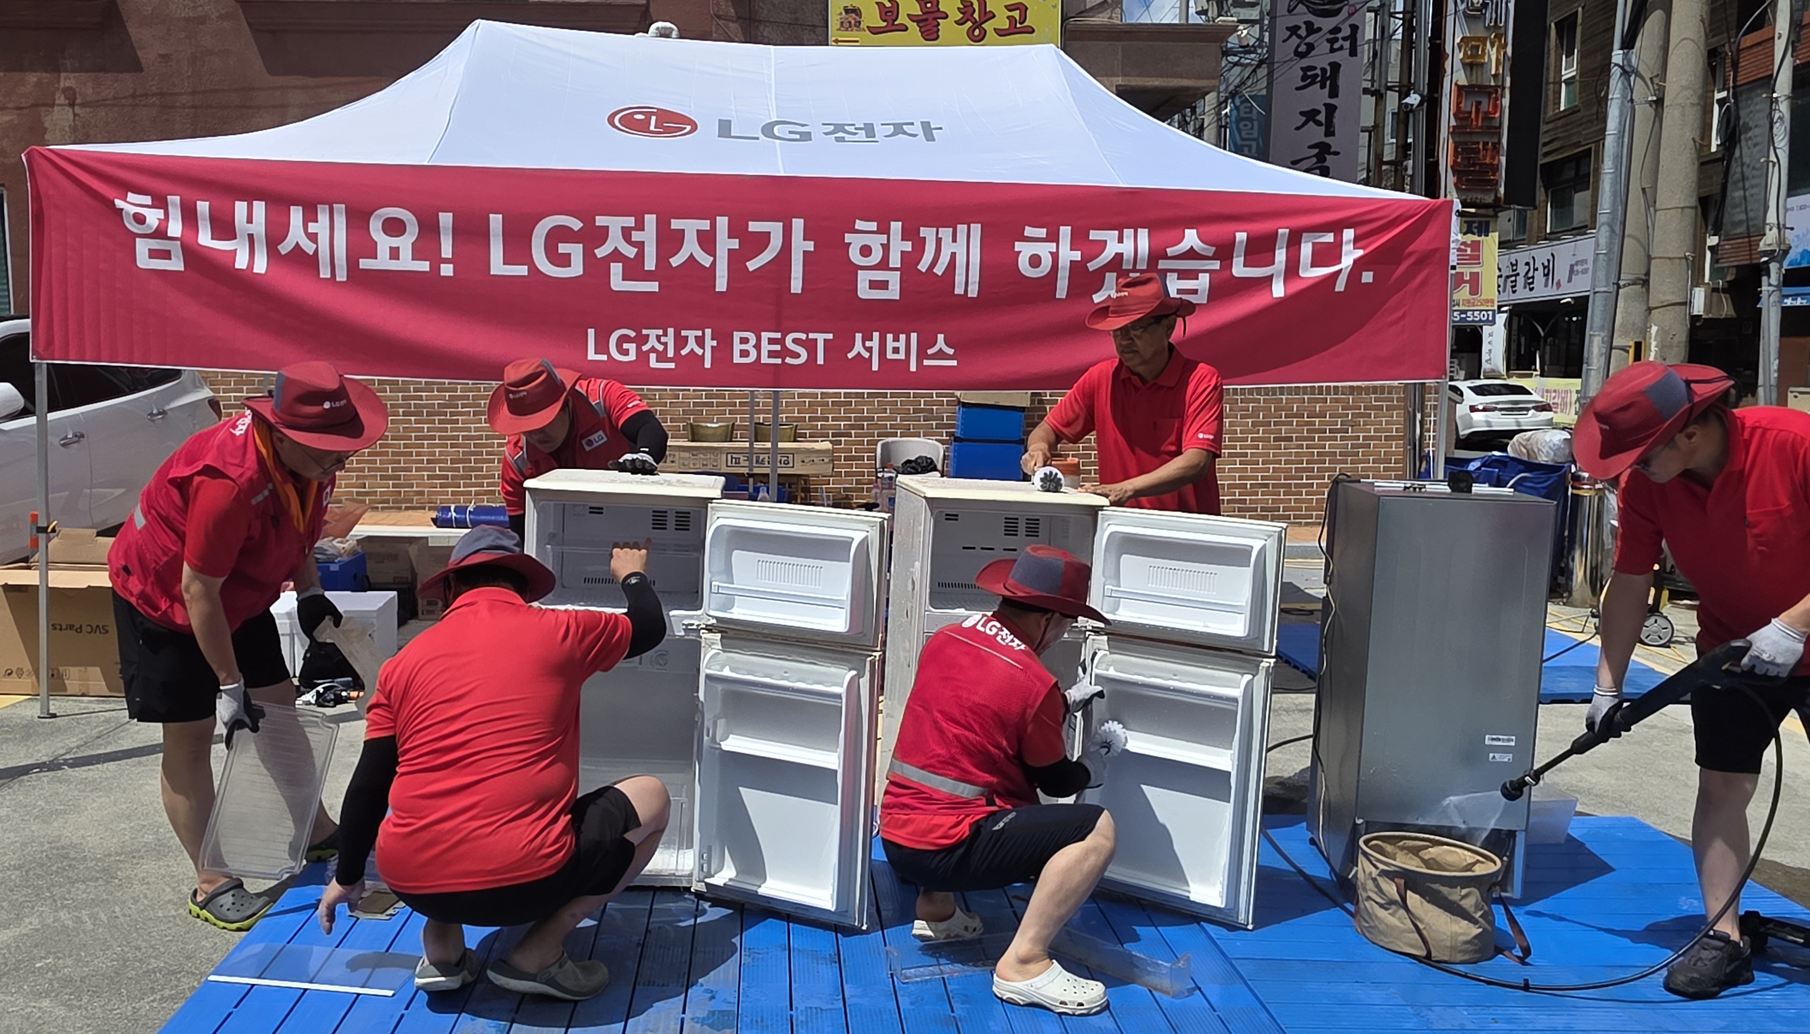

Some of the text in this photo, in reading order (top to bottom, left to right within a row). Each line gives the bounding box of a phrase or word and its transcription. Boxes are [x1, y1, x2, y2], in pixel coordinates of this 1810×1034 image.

[866, 0, 1035, 43] 보물창고
[1282, 20, 1359, 60] 장터
[717, 118, 943, 143] LG전자
[114, 191, 1374, 304] 힘내세요! LG전자가 함께 하겠습니다.
[586, 328, 958, 372] LG전자 BEST 서비스
[51, 623, 109, 634] SVC Parts
[975, 616, 1026, 651] LG전자
